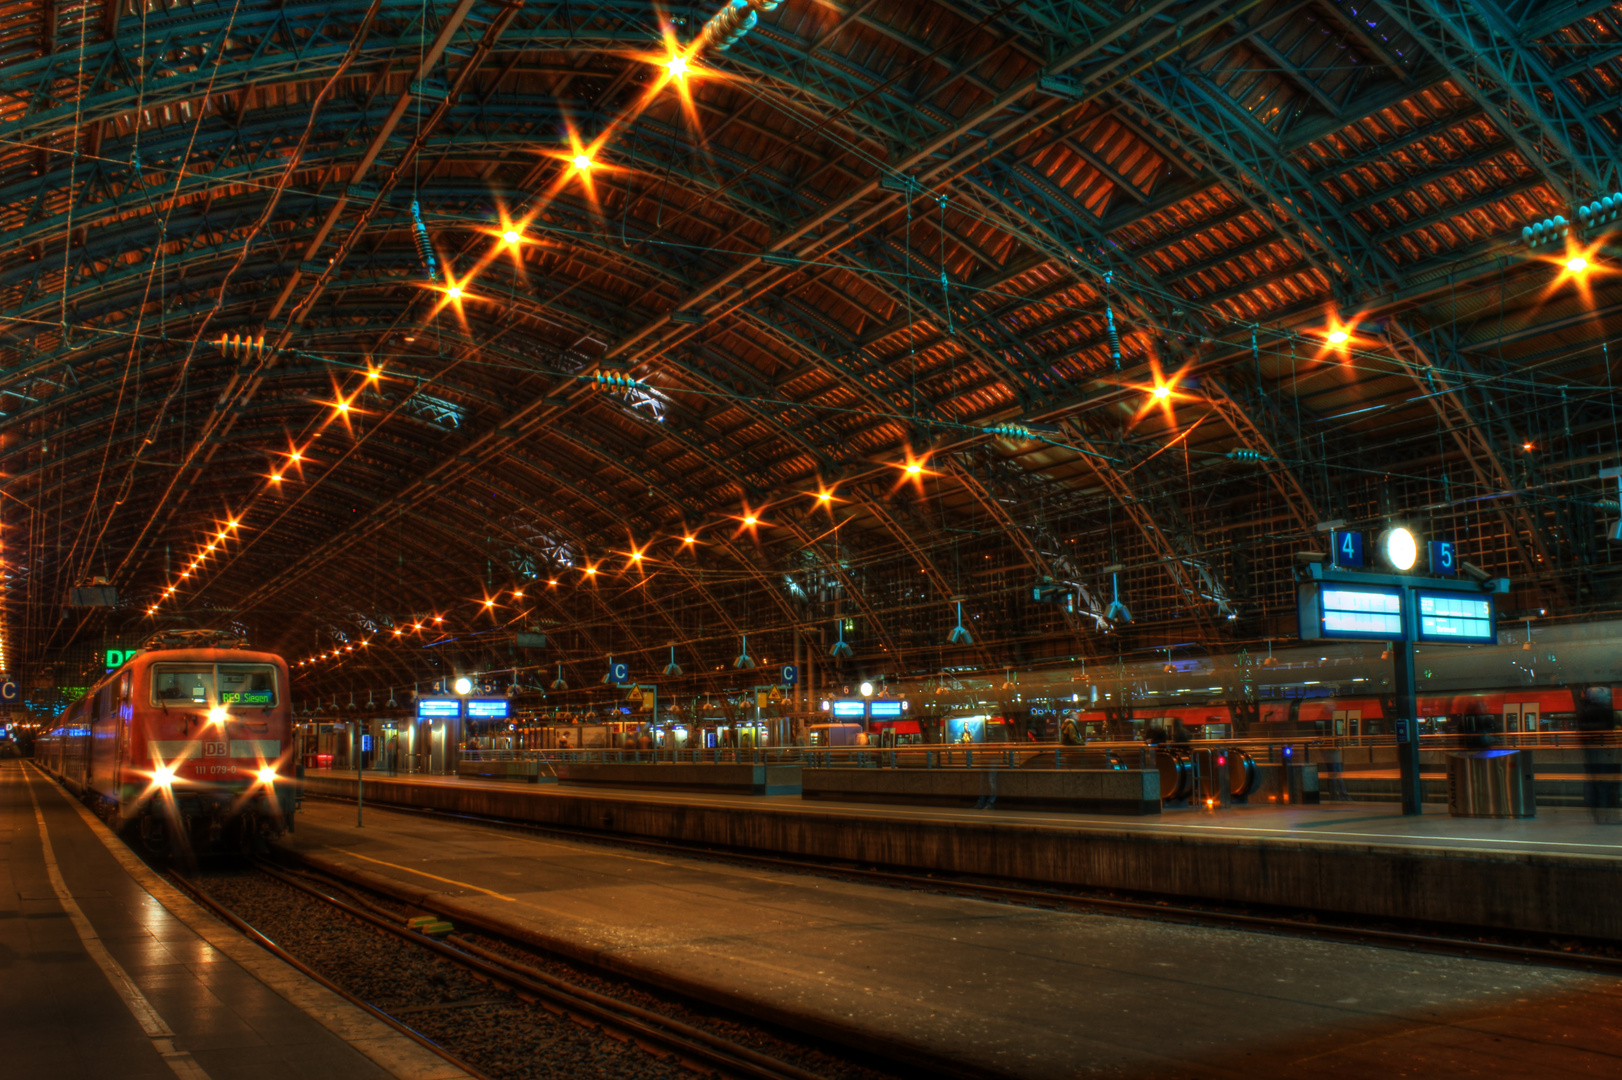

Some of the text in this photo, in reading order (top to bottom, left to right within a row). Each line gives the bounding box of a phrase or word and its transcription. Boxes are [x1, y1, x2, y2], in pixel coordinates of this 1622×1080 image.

[1342, 532, 1354, 559] 4
[1441, 543, 1453, 568] 5
[614, 664, 626, 679] C
[783, 666, 793, 681] C
[2, 682, 16, 699] C
[433, 682, 440, 691] 4
[843, 686, 849, 694] 6
[222, 693, 269, 703] RE9 Siegen
[901, 701, 908, 710] B
[1426, 717, 1432, 726] 2
[6, 723, 13, 731] D
[207, 743, 226, 755] DB
[195, 765, 237, 774] 111 079-0
